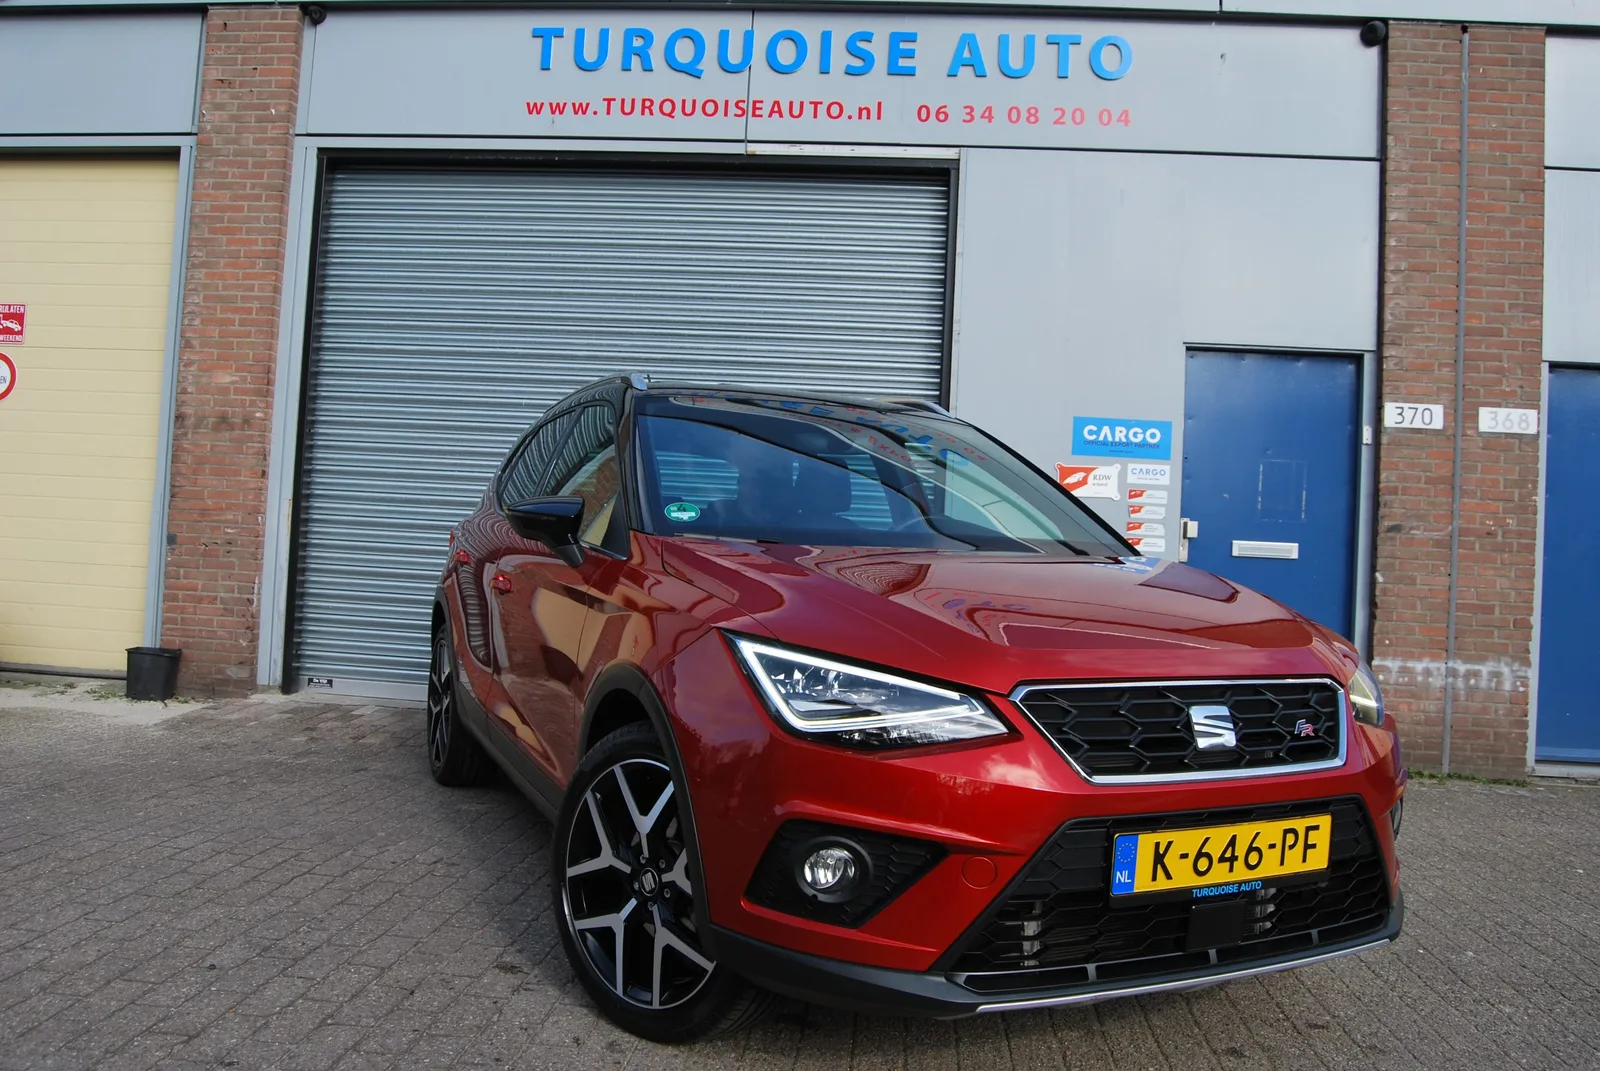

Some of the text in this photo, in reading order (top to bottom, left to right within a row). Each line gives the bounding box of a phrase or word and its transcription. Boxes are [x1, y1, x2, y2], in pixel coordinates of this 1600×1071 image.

[531, 26, 1134, 80] TURQUOISE AUTO
[526, 97, 1131, 127] www.TURQUOISEAUTO.nl 06 34 08 20 04
[1394, 406, 1433, 426] 370
[1487, 410, 1530, 431] 368
[1083, 424, 1161, 444] CARGO
[1131, 467, 1166, 476] CARGO
[1151, 824, 1320, 882] K-646-PF
[1115, 870, 1132, 884] NL
[1192, 881, 1262, 898] TURQUOISE AUTO
